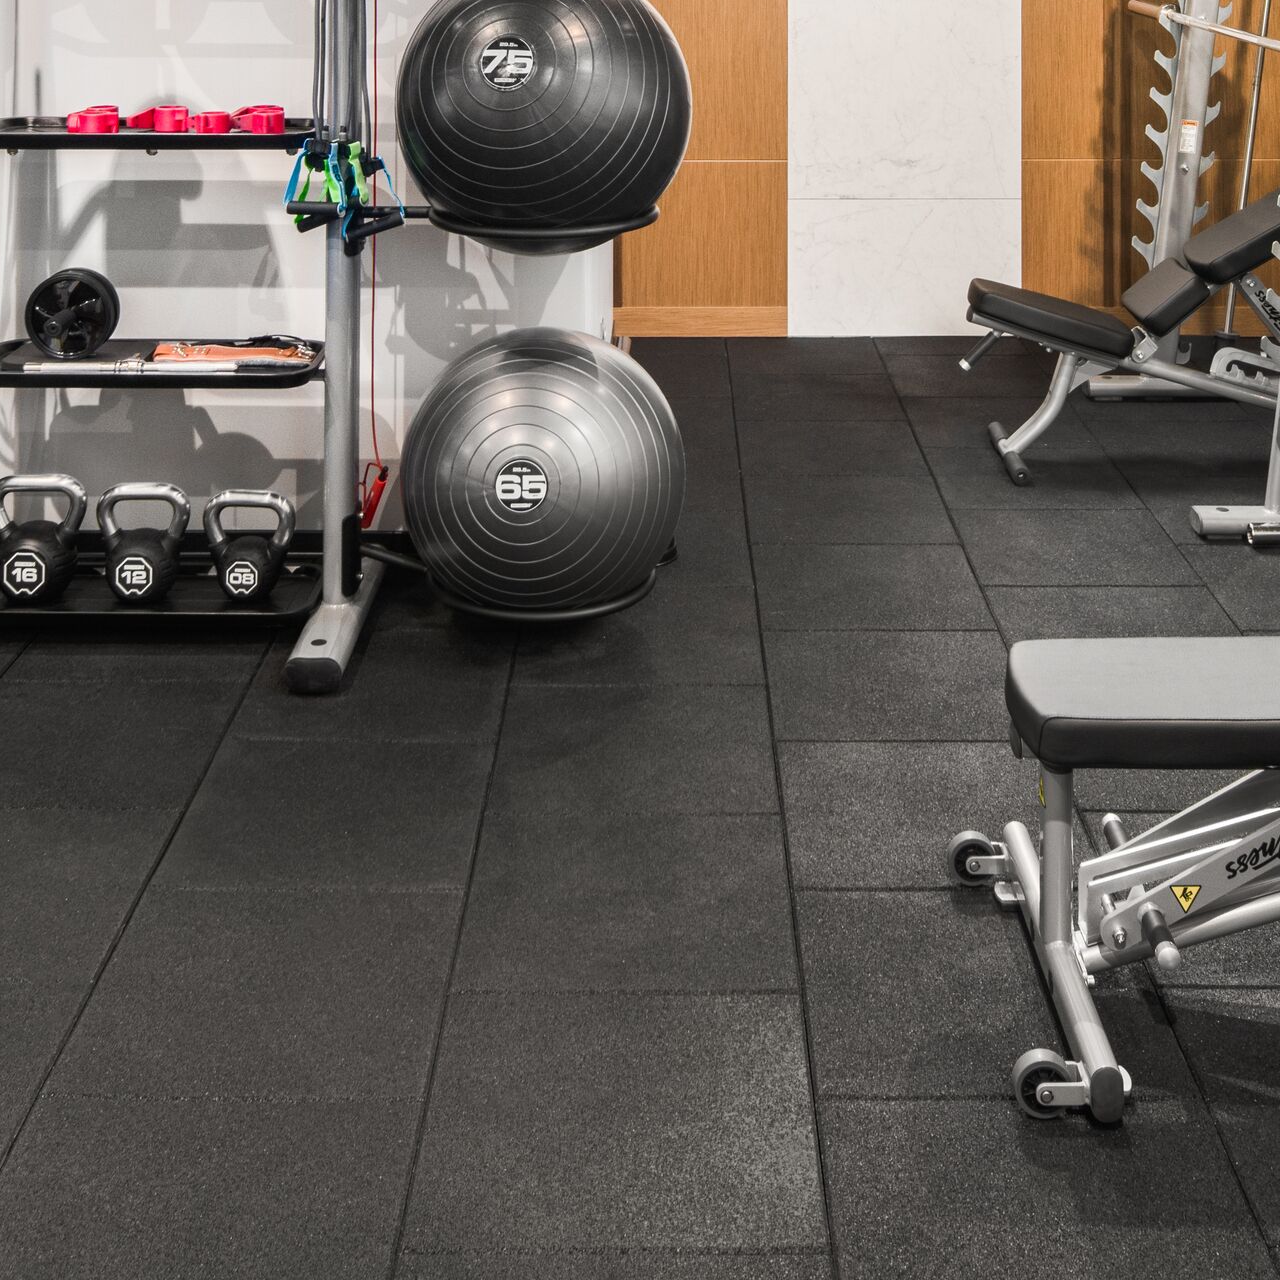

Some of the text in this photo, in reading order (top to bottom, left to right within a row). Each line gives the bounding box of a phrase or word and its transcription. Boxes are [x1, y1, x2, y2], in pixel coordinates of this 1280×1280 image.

[481, 49, 533, 74] 75
[495, 473, 547, 500] 65
[11, 567, 38, 583] 16
[120, 570, 147, 585] 12
[229, 572, 254, 585] 08
